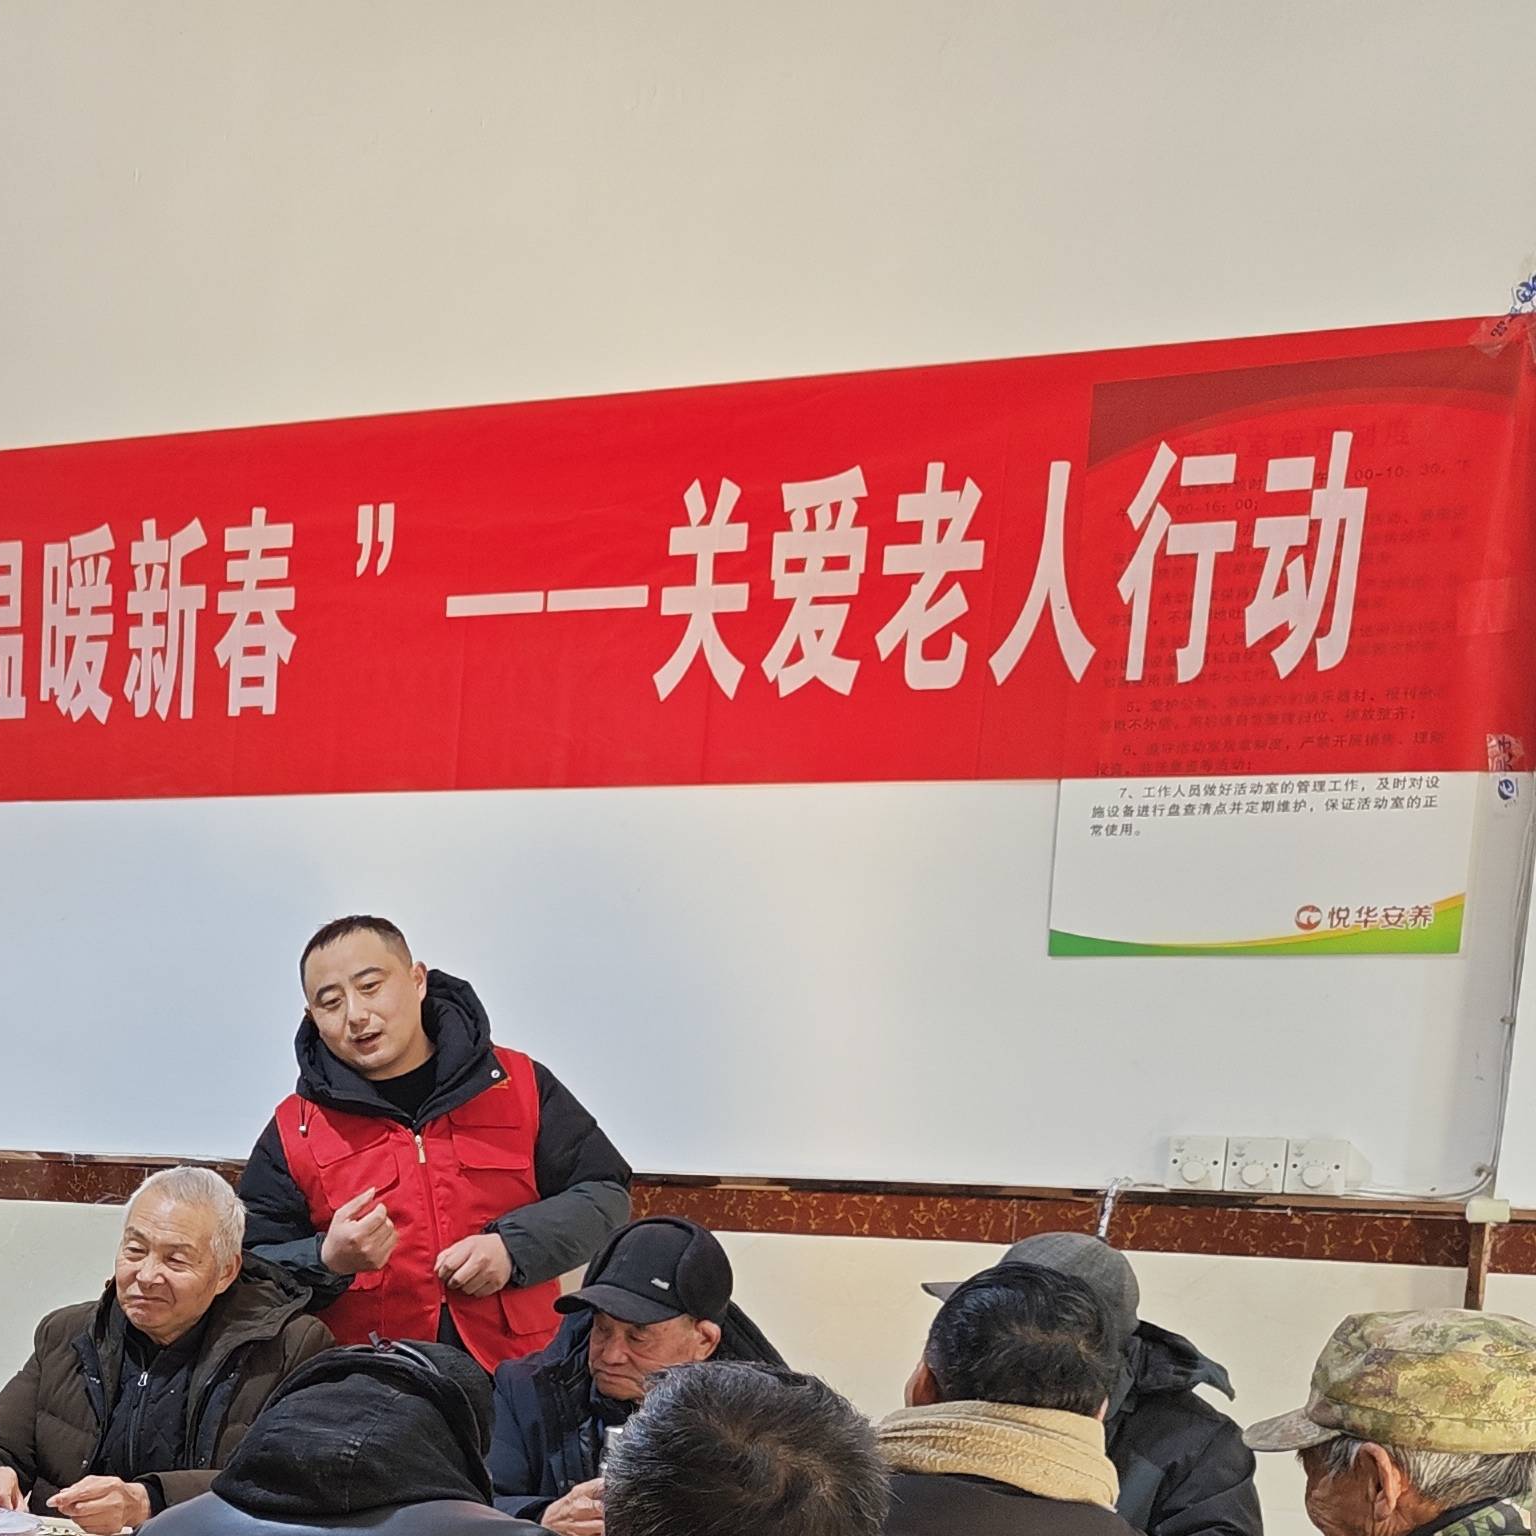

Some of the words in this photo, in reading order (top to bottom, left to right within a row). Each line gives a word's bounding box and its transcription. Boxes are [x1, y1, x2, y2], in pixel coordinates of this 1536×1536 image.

[1090, 823, 1141, 837] 常使用。
[1328, 905, 1433, 929] 悦华安养
